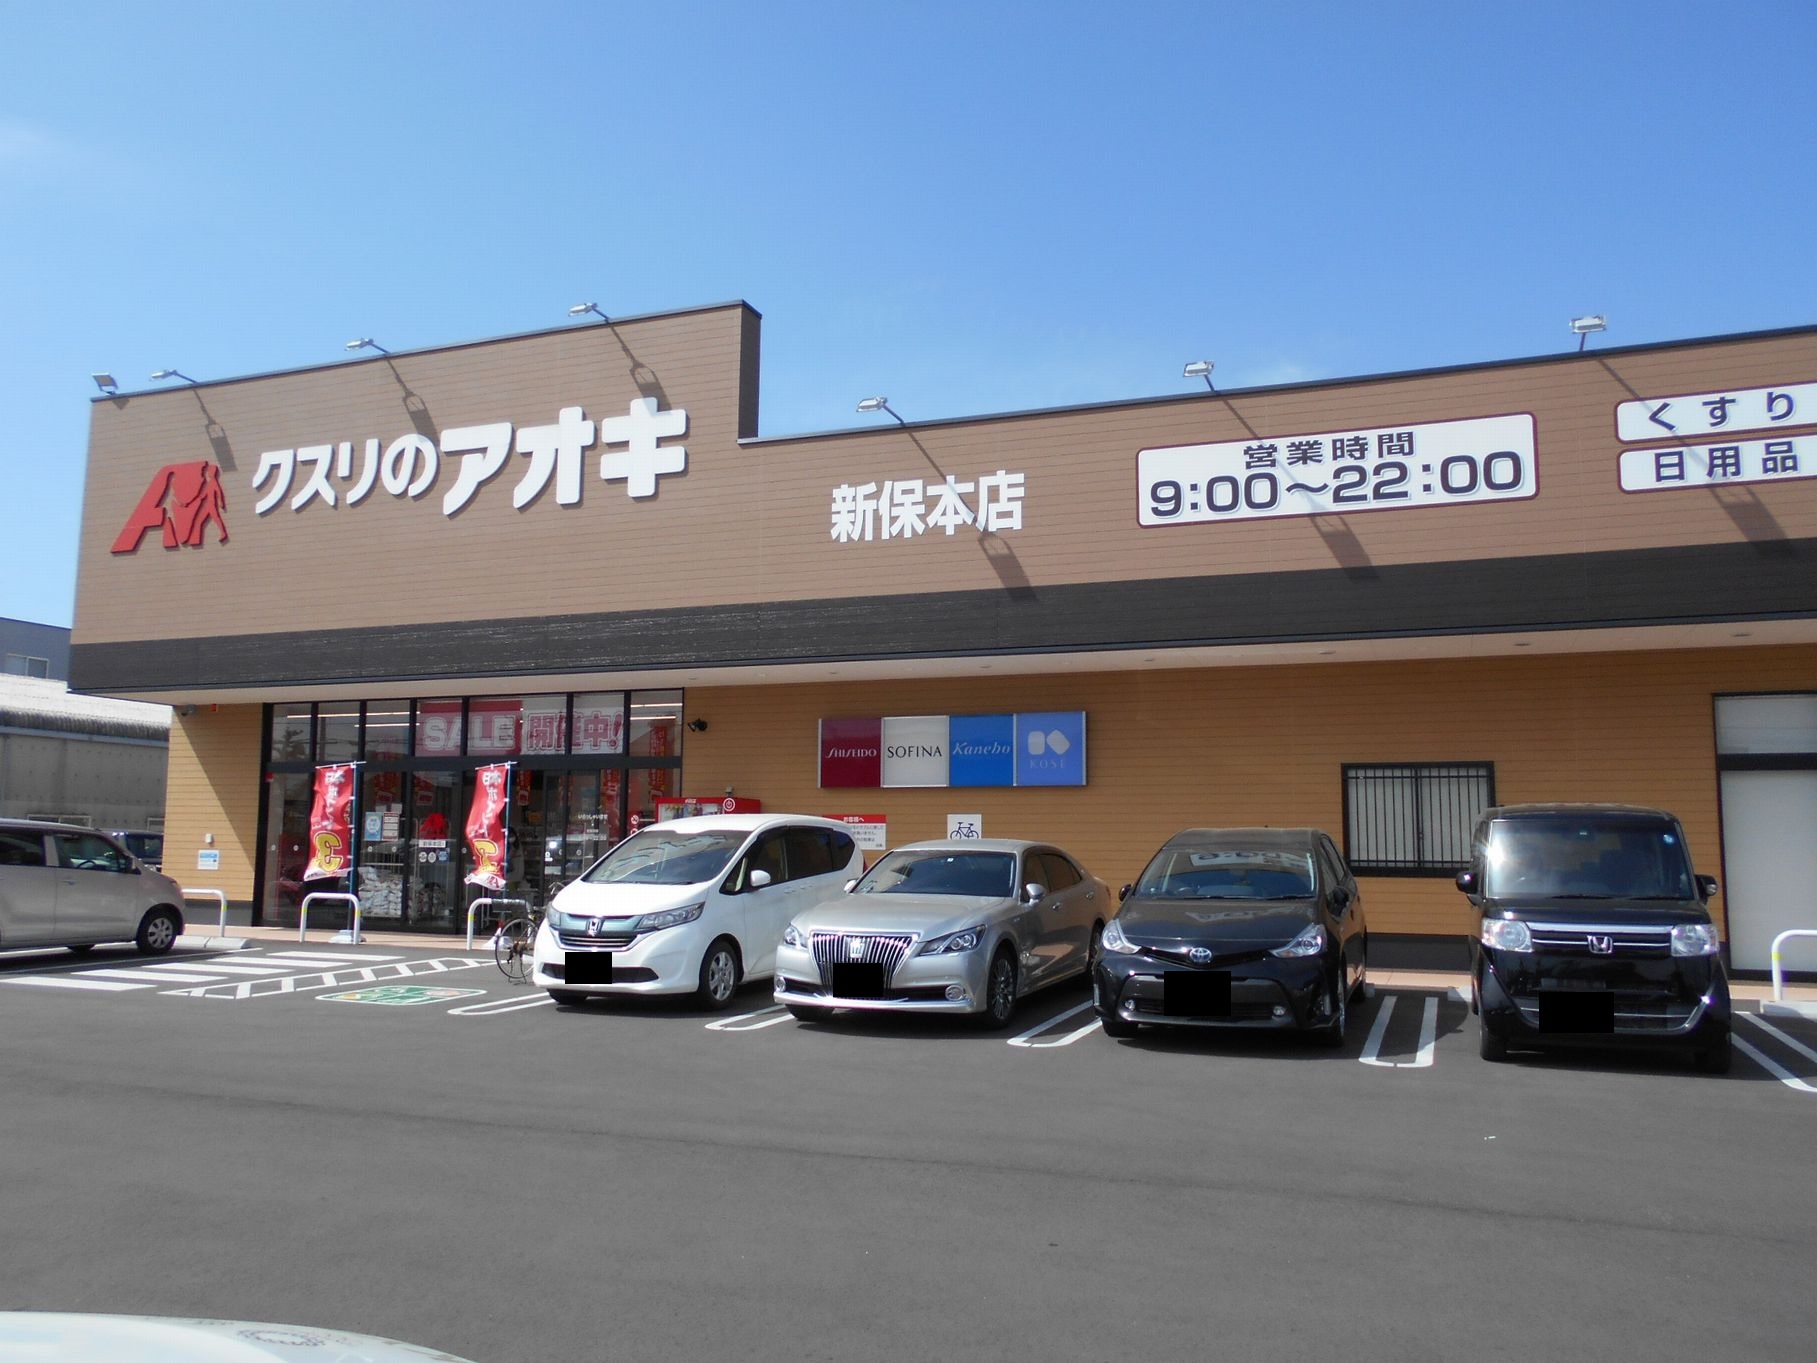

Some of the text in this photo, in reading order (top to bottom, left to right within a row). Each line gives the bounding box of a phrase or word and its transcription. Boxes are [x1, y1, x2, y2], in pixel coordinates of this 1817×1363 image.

[1648, 391, 1794, 431] くすり
[252, 396, 688, 517] クスリのアオキ
[1244, 427, 1417, 471] 営業時間
[1653, 440, 1799, 482] 日用品
[830, 468, 1026, 543] 新保本店
[423, 715, 514, 751] SALE
[825, 748, 877, 758] SHISEIDO
[887, 744, 943, 758] SOFINA
[952, 741, 1011, 756] Kanebo
